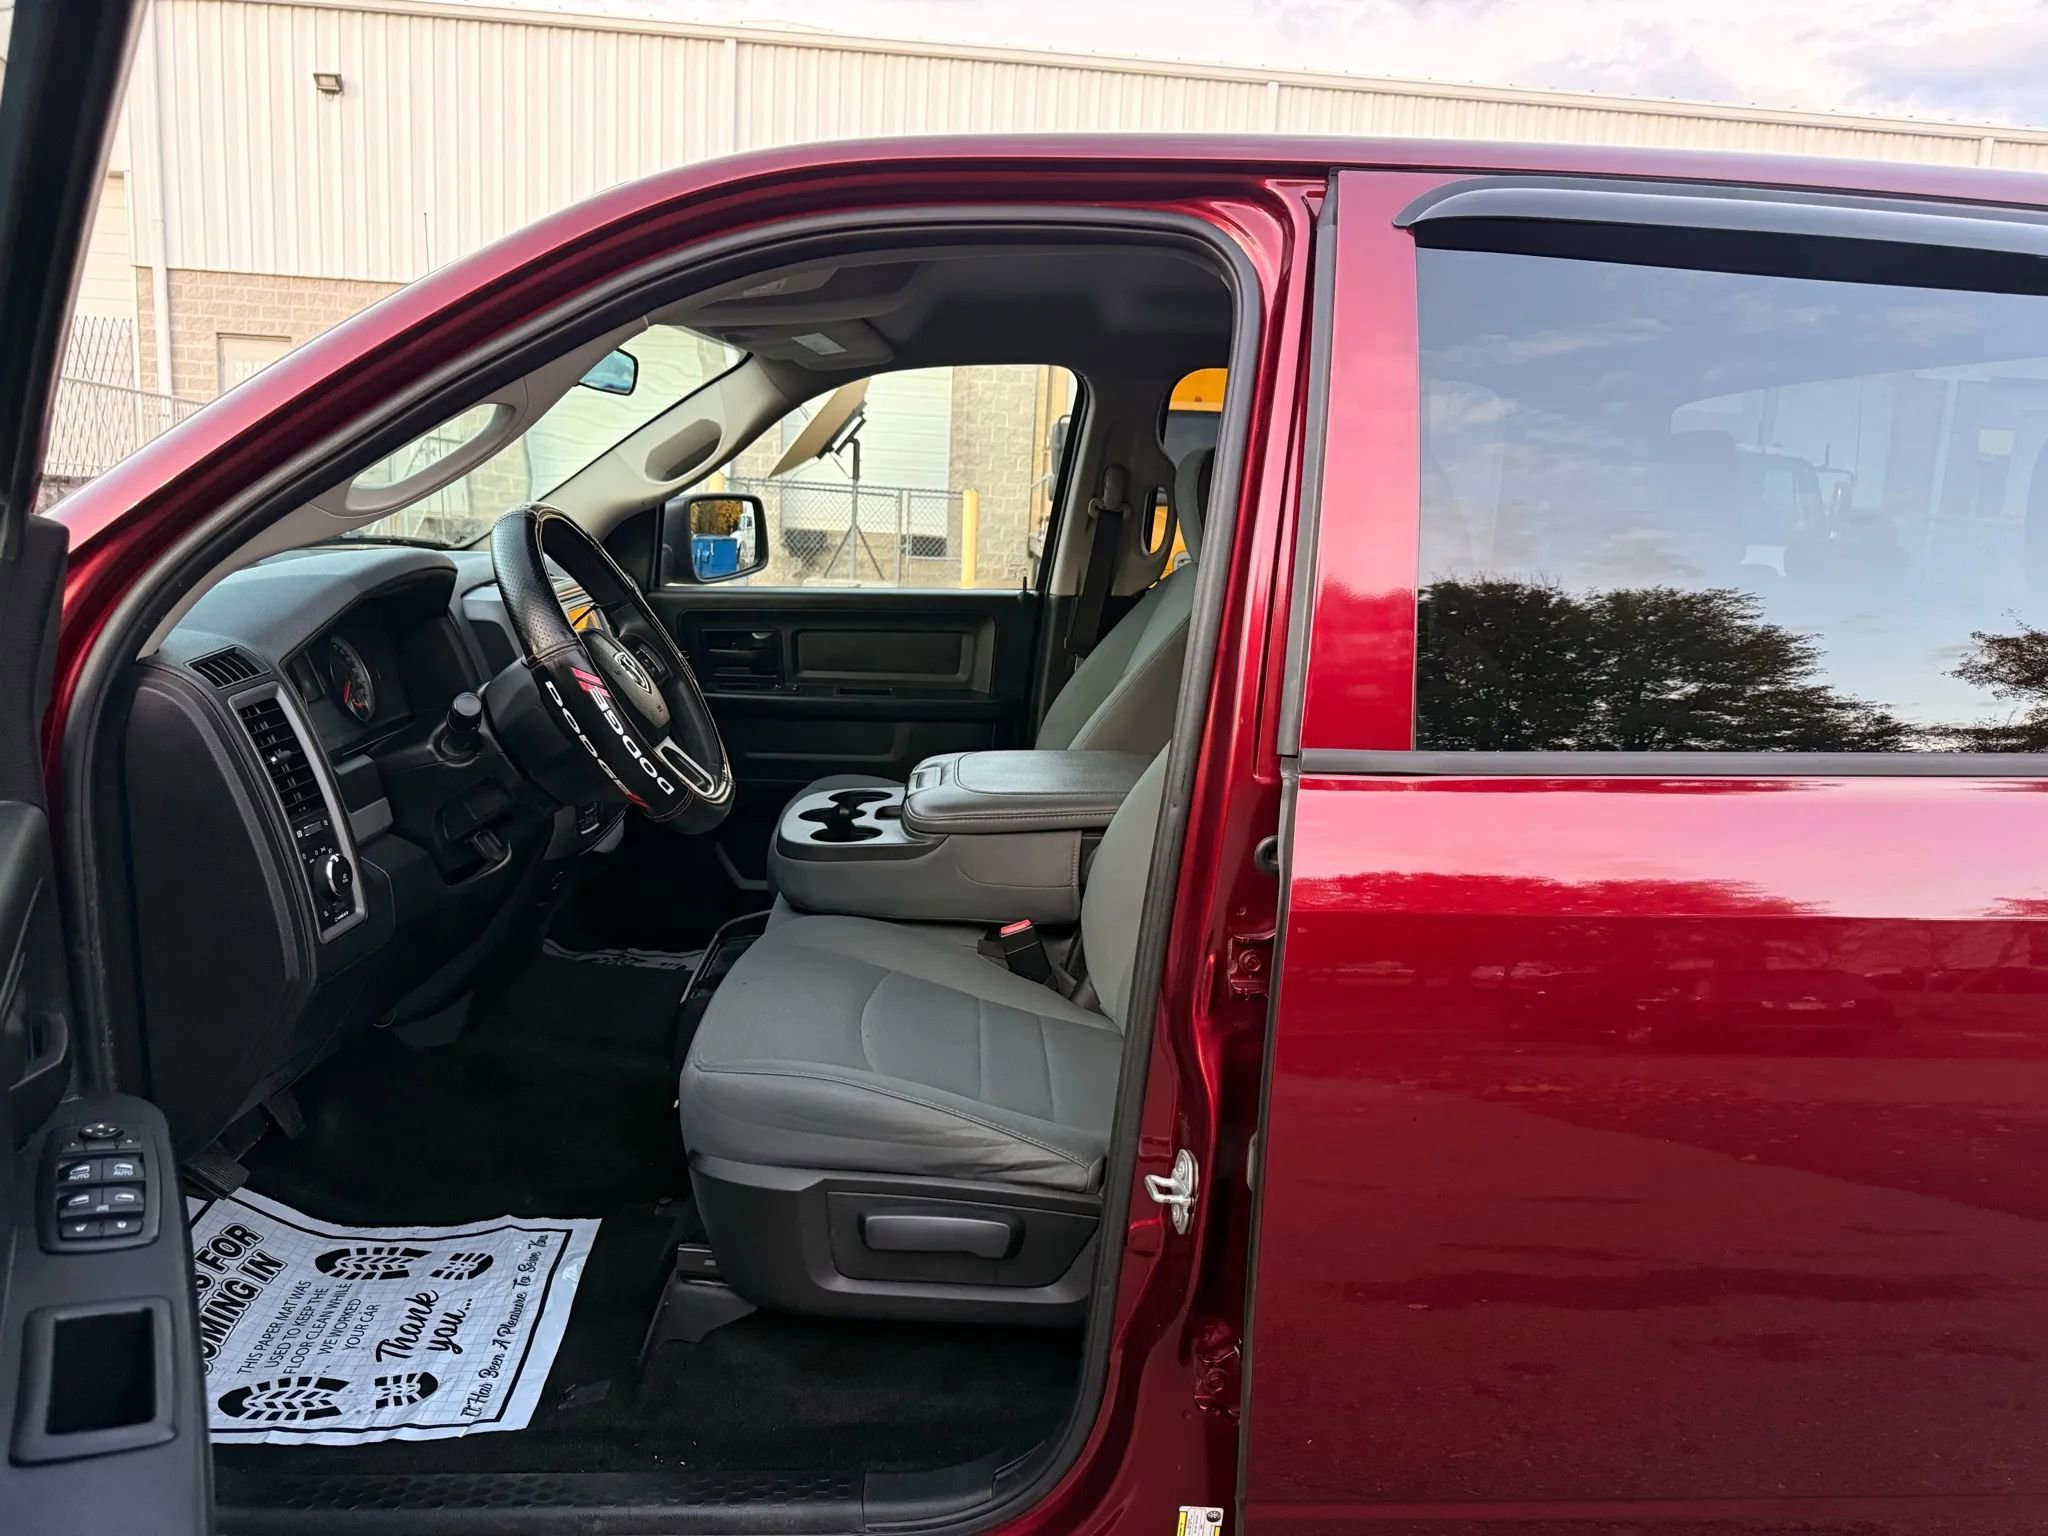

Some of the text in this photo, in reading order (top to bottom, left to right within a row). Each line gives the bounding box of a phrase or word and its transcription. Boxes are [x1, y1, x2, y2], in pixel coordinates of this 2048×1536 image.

[590, 686, 675, 795] DODGE
[194, 1222, 264, 1274] FOR
[517, 1251, 542, 1273] Serve
[528, 1234, 549, 1249] You
[512, 1276, 531, 1290] To
[199, 1249, 288, 1376] OMING IN
[237, 1280, 312, 1374] THIS PAPER MAT WAS
[264, 1288, 329, 1368] USED TO KEEP THE
[283, 1282, 352, 1374] FLOOR CLEAN WHILE
[317, 1299, 362, 1355] WE WORKED
[342, 1304, 381, 1351] YOUR CAR
[375, 1289, 439, 1363] Thank
[426, 1298, 473, 1354] you...
[496, 1291, 528, 1337] Pleasure
[478, 1353, 505, 1379] Been
[491, 1339, 512, 1350] A
[466, 1383, 493, 1404] Has
